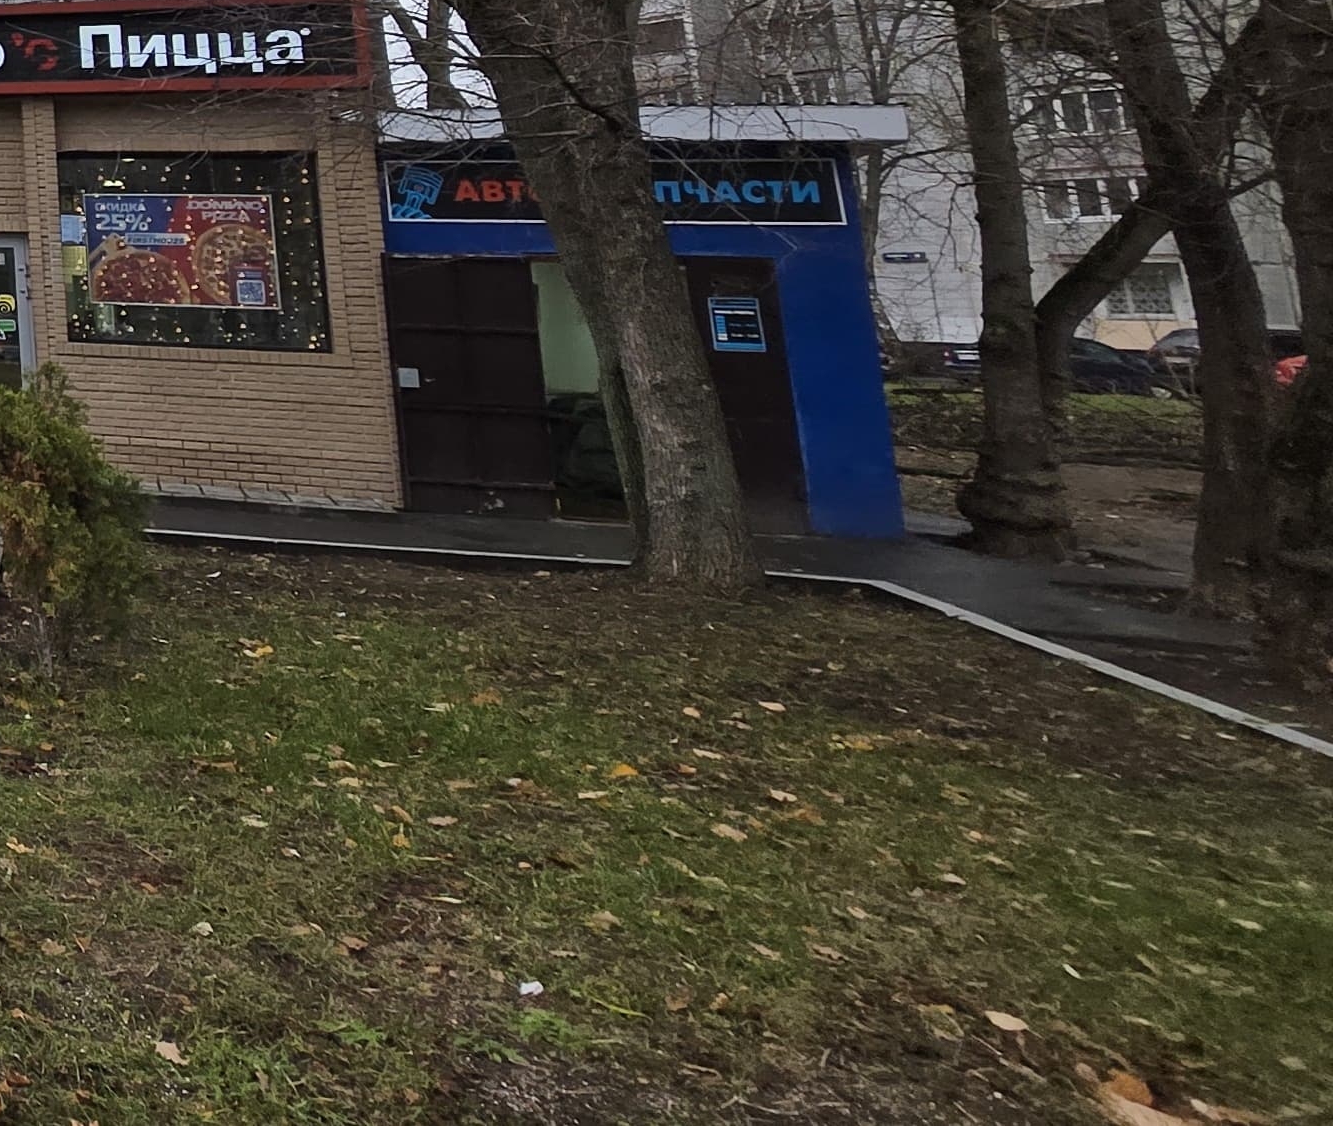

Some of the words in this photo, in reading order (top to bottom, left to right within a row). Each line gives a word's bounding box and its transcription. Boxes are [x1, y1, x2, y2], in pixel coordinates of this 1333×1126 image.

[79, 24, 306, 74] Пицца
[96, 214, 149, 231] 25%
[201, 210, 251, 222] PIZZA
